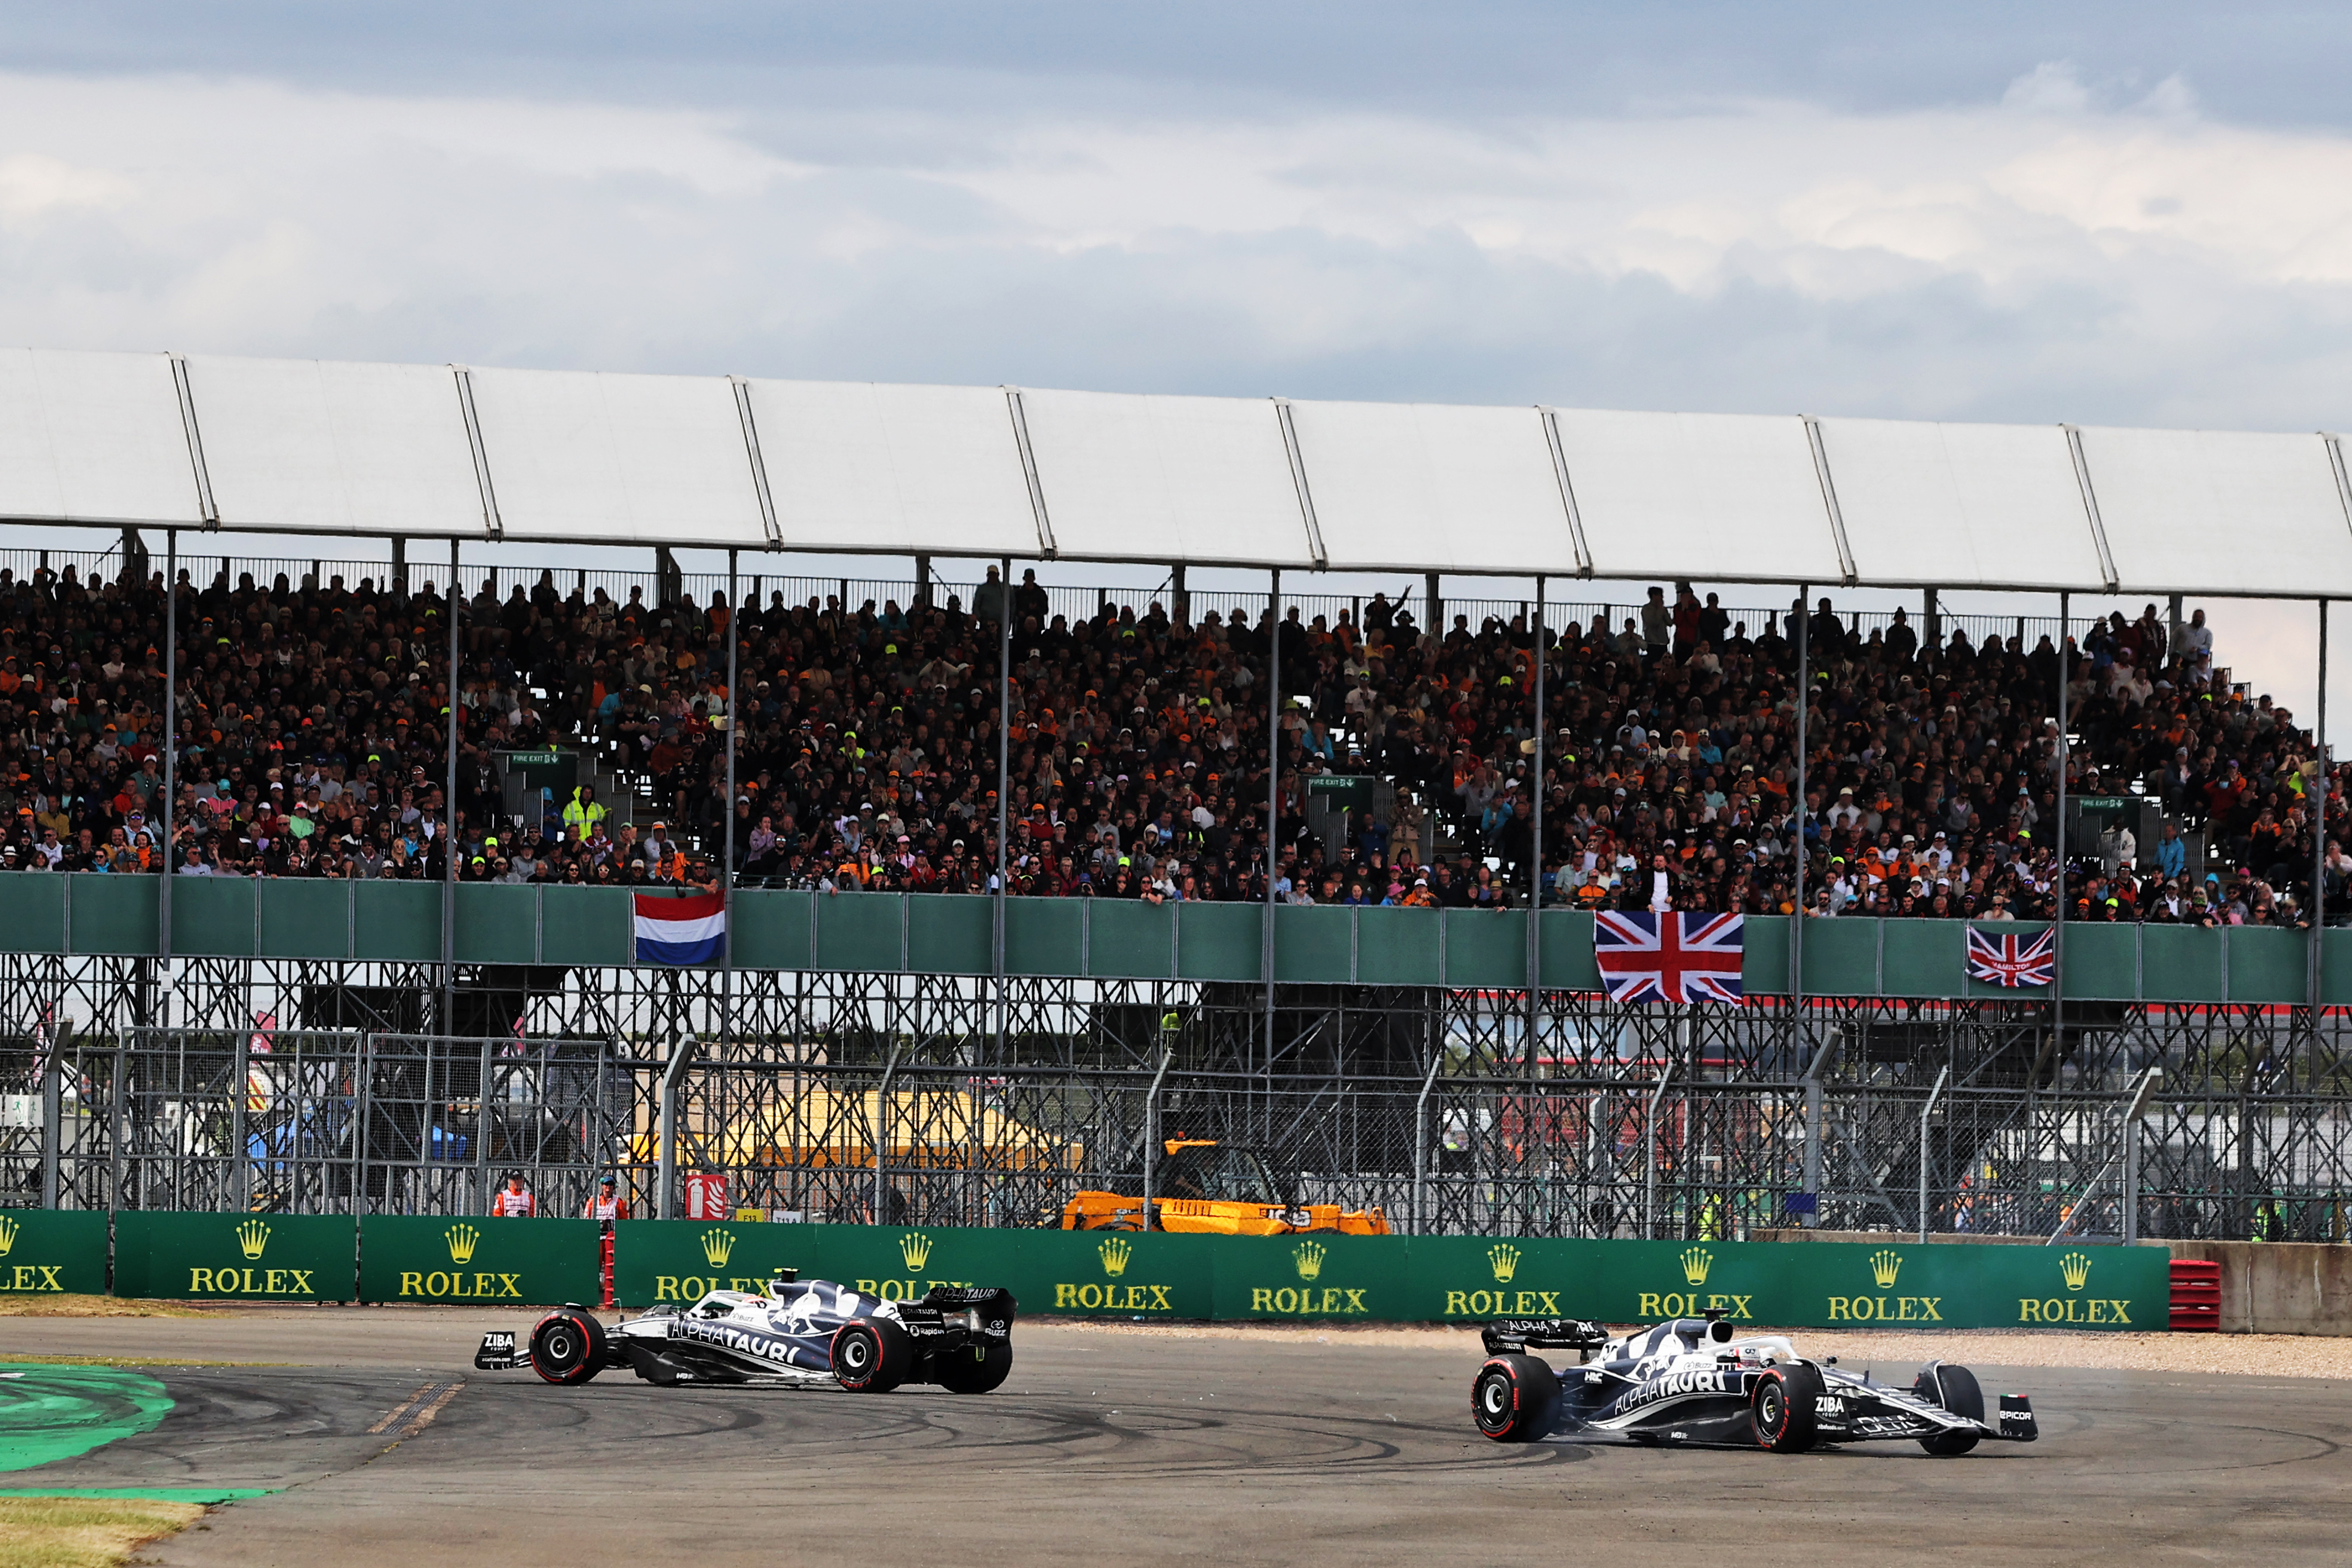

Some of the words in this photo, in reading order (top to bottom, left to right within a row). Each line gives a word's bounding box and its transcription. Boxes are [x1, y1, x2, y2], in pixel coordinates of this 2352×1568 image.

[190, 1268, 314, 1294] ROLEX
[399, 1271, 522, 1297] ROLEX
[1055, 1283, 1172, 1310] ROLEX
[1251, 1287, 1368, 1314] ROLEX
[1445, 1290, 1561, 1315] ROLEX
[1638, 1293, 1753, 1319] ROLEX
[1828, 1296, 1943, 1321] ROLEX
[2018, 1299, 2132, 1324] ROLEX
[484, 1334, 514, 1347] ZIBA
[672, 1320, 800, 1364] ALPHATAURI
[1614, 1371, 1726, 1415] ALPHATAURI
[1815, 1396, 1844, 1413] ZIBA
